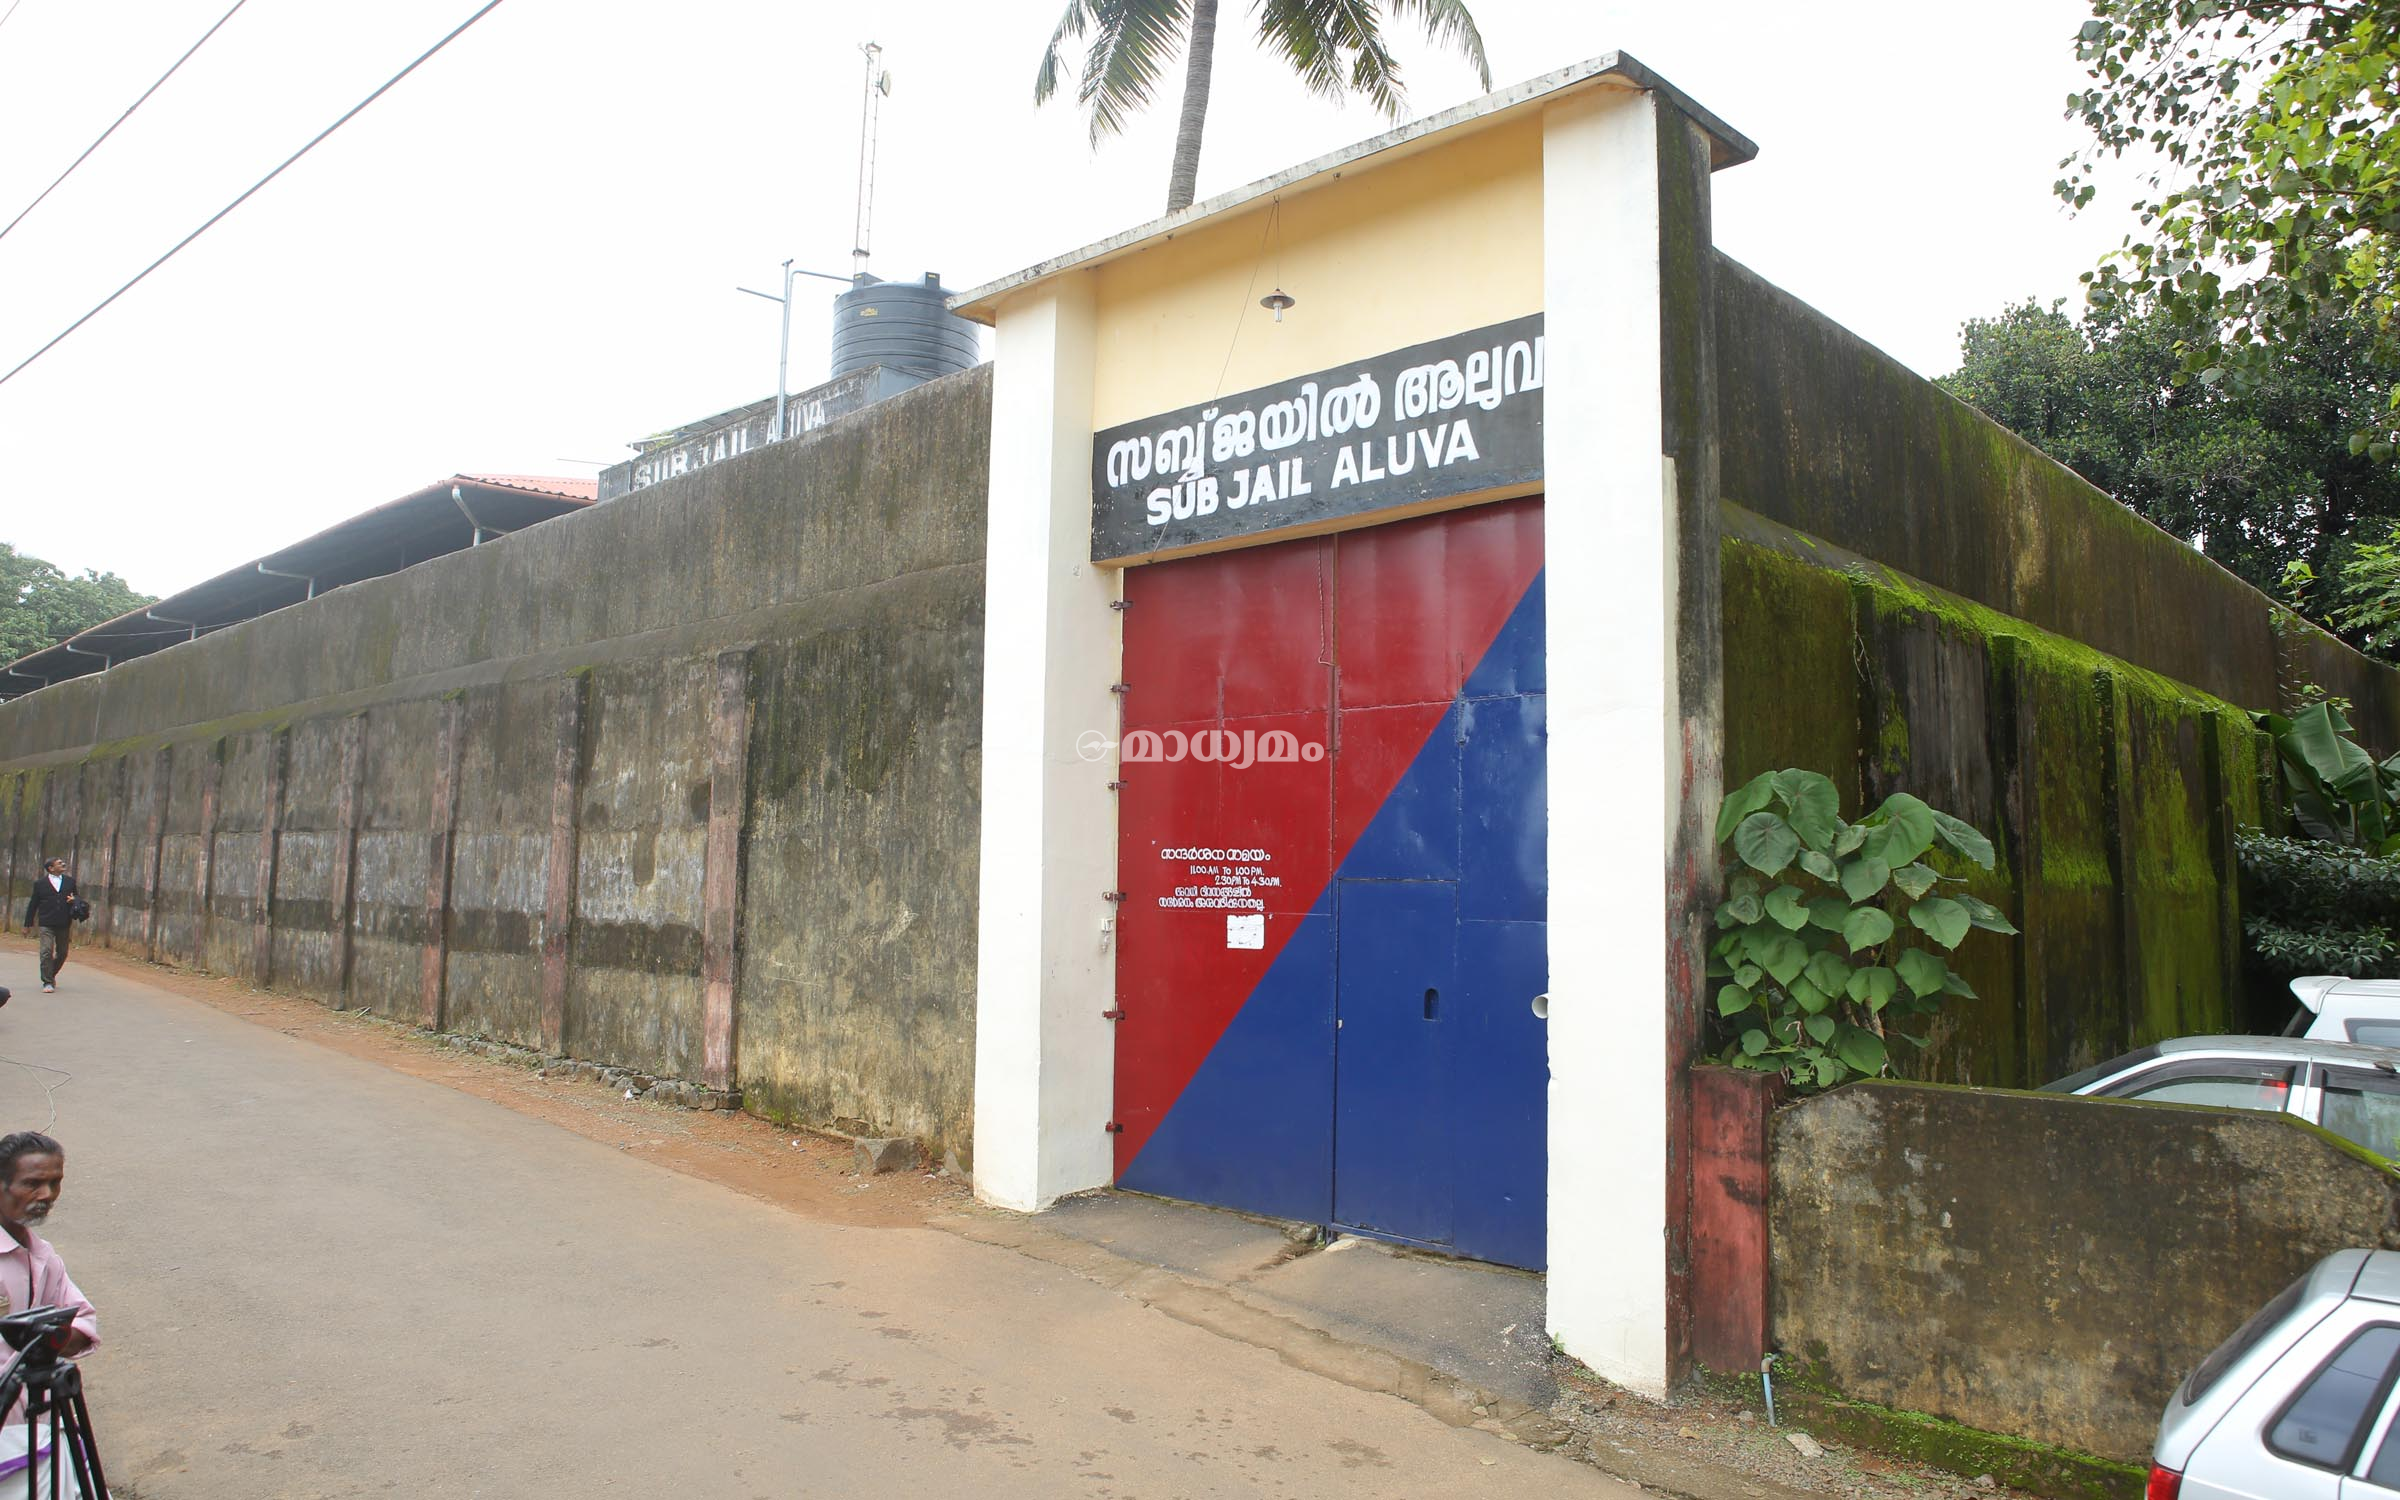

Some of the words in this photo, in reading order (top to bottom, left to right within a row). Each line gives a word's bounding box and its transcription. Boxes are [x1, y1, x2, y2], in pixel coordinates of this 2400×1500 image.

[1394, 335, 1544, 422] ആലുവ
[766, 399, 826, 444] AUVA
[1146, 472, 1220, 526] SUB
[1227, 455, 1312, 510] JAIL
[1330, 419, 1480, 489] ALUVA
[1222, 866, 1232, 875] To
[1226, 848, 1271, 862] സമയം
